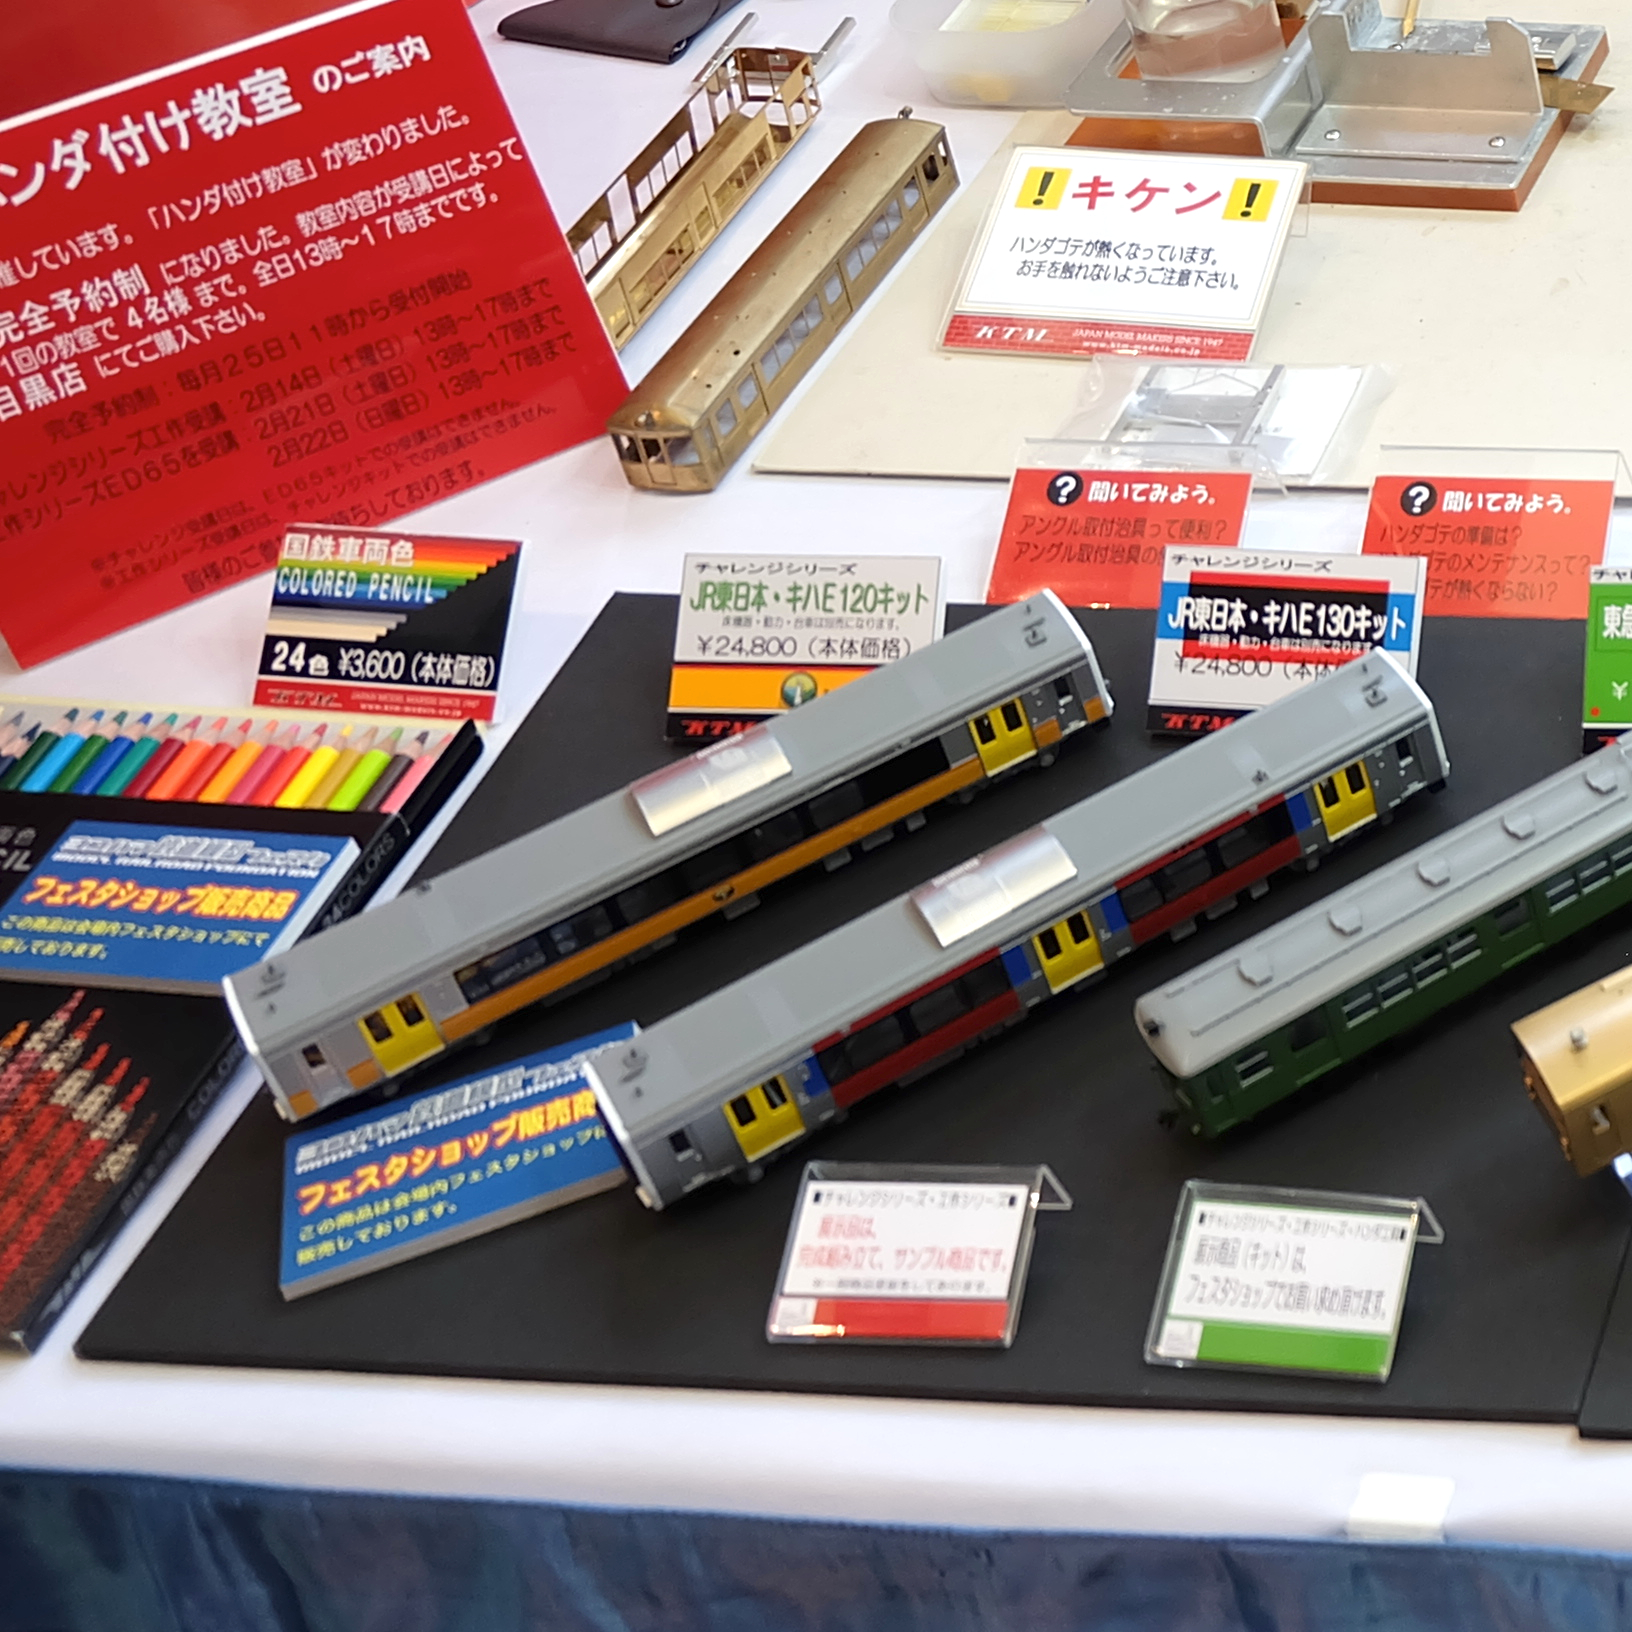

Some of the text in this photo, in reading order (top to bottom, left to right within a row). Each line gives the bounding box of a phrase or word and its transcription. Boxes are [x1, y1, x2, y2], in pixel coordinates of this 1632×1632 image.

[0, 34, 432, 207] ンダ付け教室 のご案内
[1071, 175, 1222, 215] キケン
[1009, 236, 1217, 266] ハンダゴテが熱くなっています。
[1016, 260, 1239, 291] お手を触れないようご注意下さい。
[973, 326, 1055, 342] KTM
[1087, 480, 1217, 507] 聞いてみよう。
[1441, 488, 1573, 517] 聞いてみよう。
[283, 533, 416, 567] 国鉄車両色
[1170, 552, 1332, 574] チャレンジシリーズ
[692, 562, 856, 578] チャレンジシリーズ
[278, 567, 435, 604] COLORED PENCIL
[338, 648, 406, 680] ¥3,600
[411, 651, 495, 687] (本体価格)
